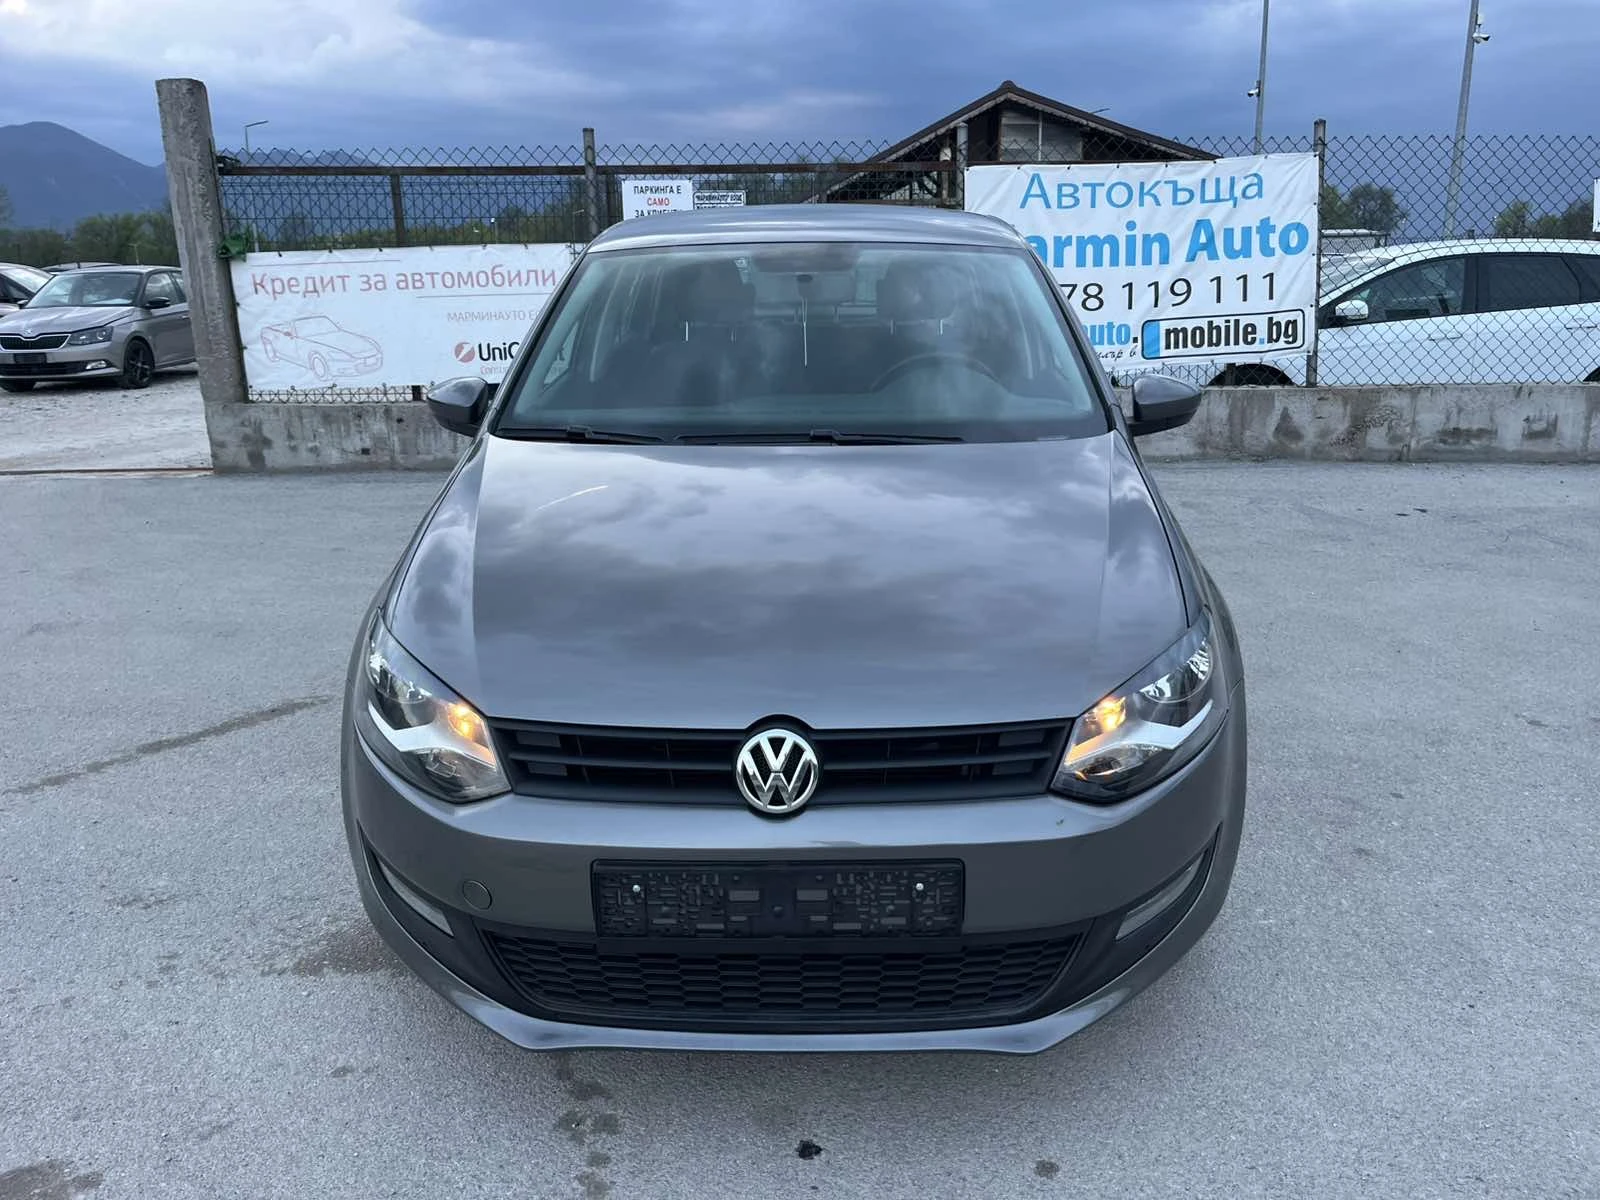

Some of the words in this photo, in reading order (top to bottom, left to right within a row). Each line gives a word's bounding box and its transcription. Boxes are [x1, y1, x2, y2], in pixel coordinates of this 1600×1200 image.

[633, 185, 674, 195] ПАРКИНГА
[676, 185, 682, 194] Е
[646, 197, 670, 206] САМО
[1019, 171, 1264, 210] Автокъща
[1186, 216, 1310, 264] Auto
[251, 264, 351, 300] Кредит
[359, 272, 388, 292] за
[395, 264, 557, 291] автомобили
[1122, 277, 1193, 311] 119
[1210, 272, 1275, 304] 111
[446, 310, 526, 322] МАРМИНАУТО
[1164, 316, 1299, 350] mobile.bg
